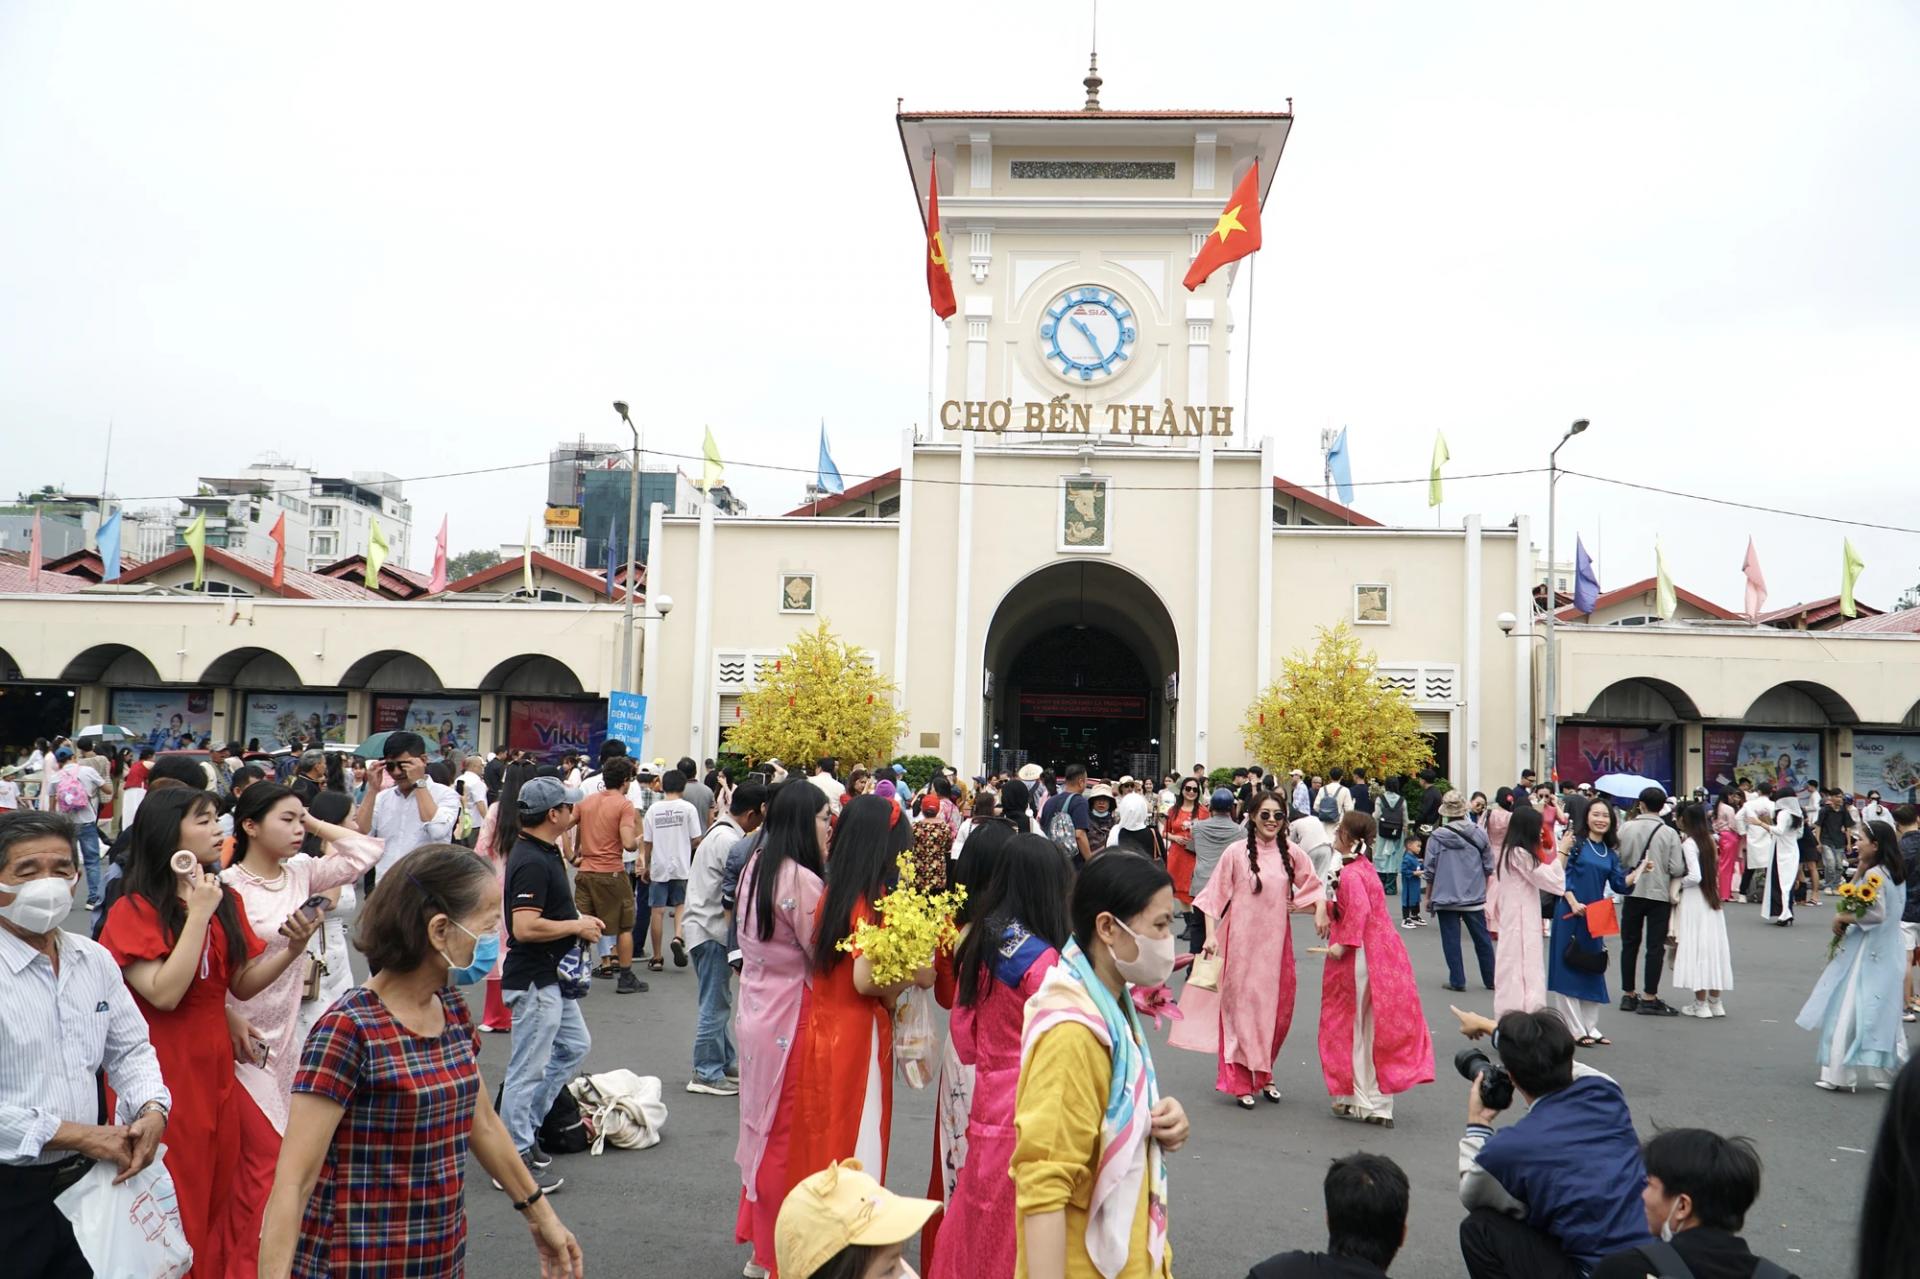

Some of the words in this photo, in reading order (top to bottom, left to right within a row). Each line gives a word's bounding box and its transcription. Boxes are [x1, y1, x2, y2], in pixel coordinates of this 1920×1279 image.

[940, 397, 1011, 435] CHỢ
[1023, 393, 1094, 433] BẾN
[1105, 398, 1234, 436] THÀNH
[533, 719, 589, 745] Vikki
[1583, 743, 1644, 772] Vikki
